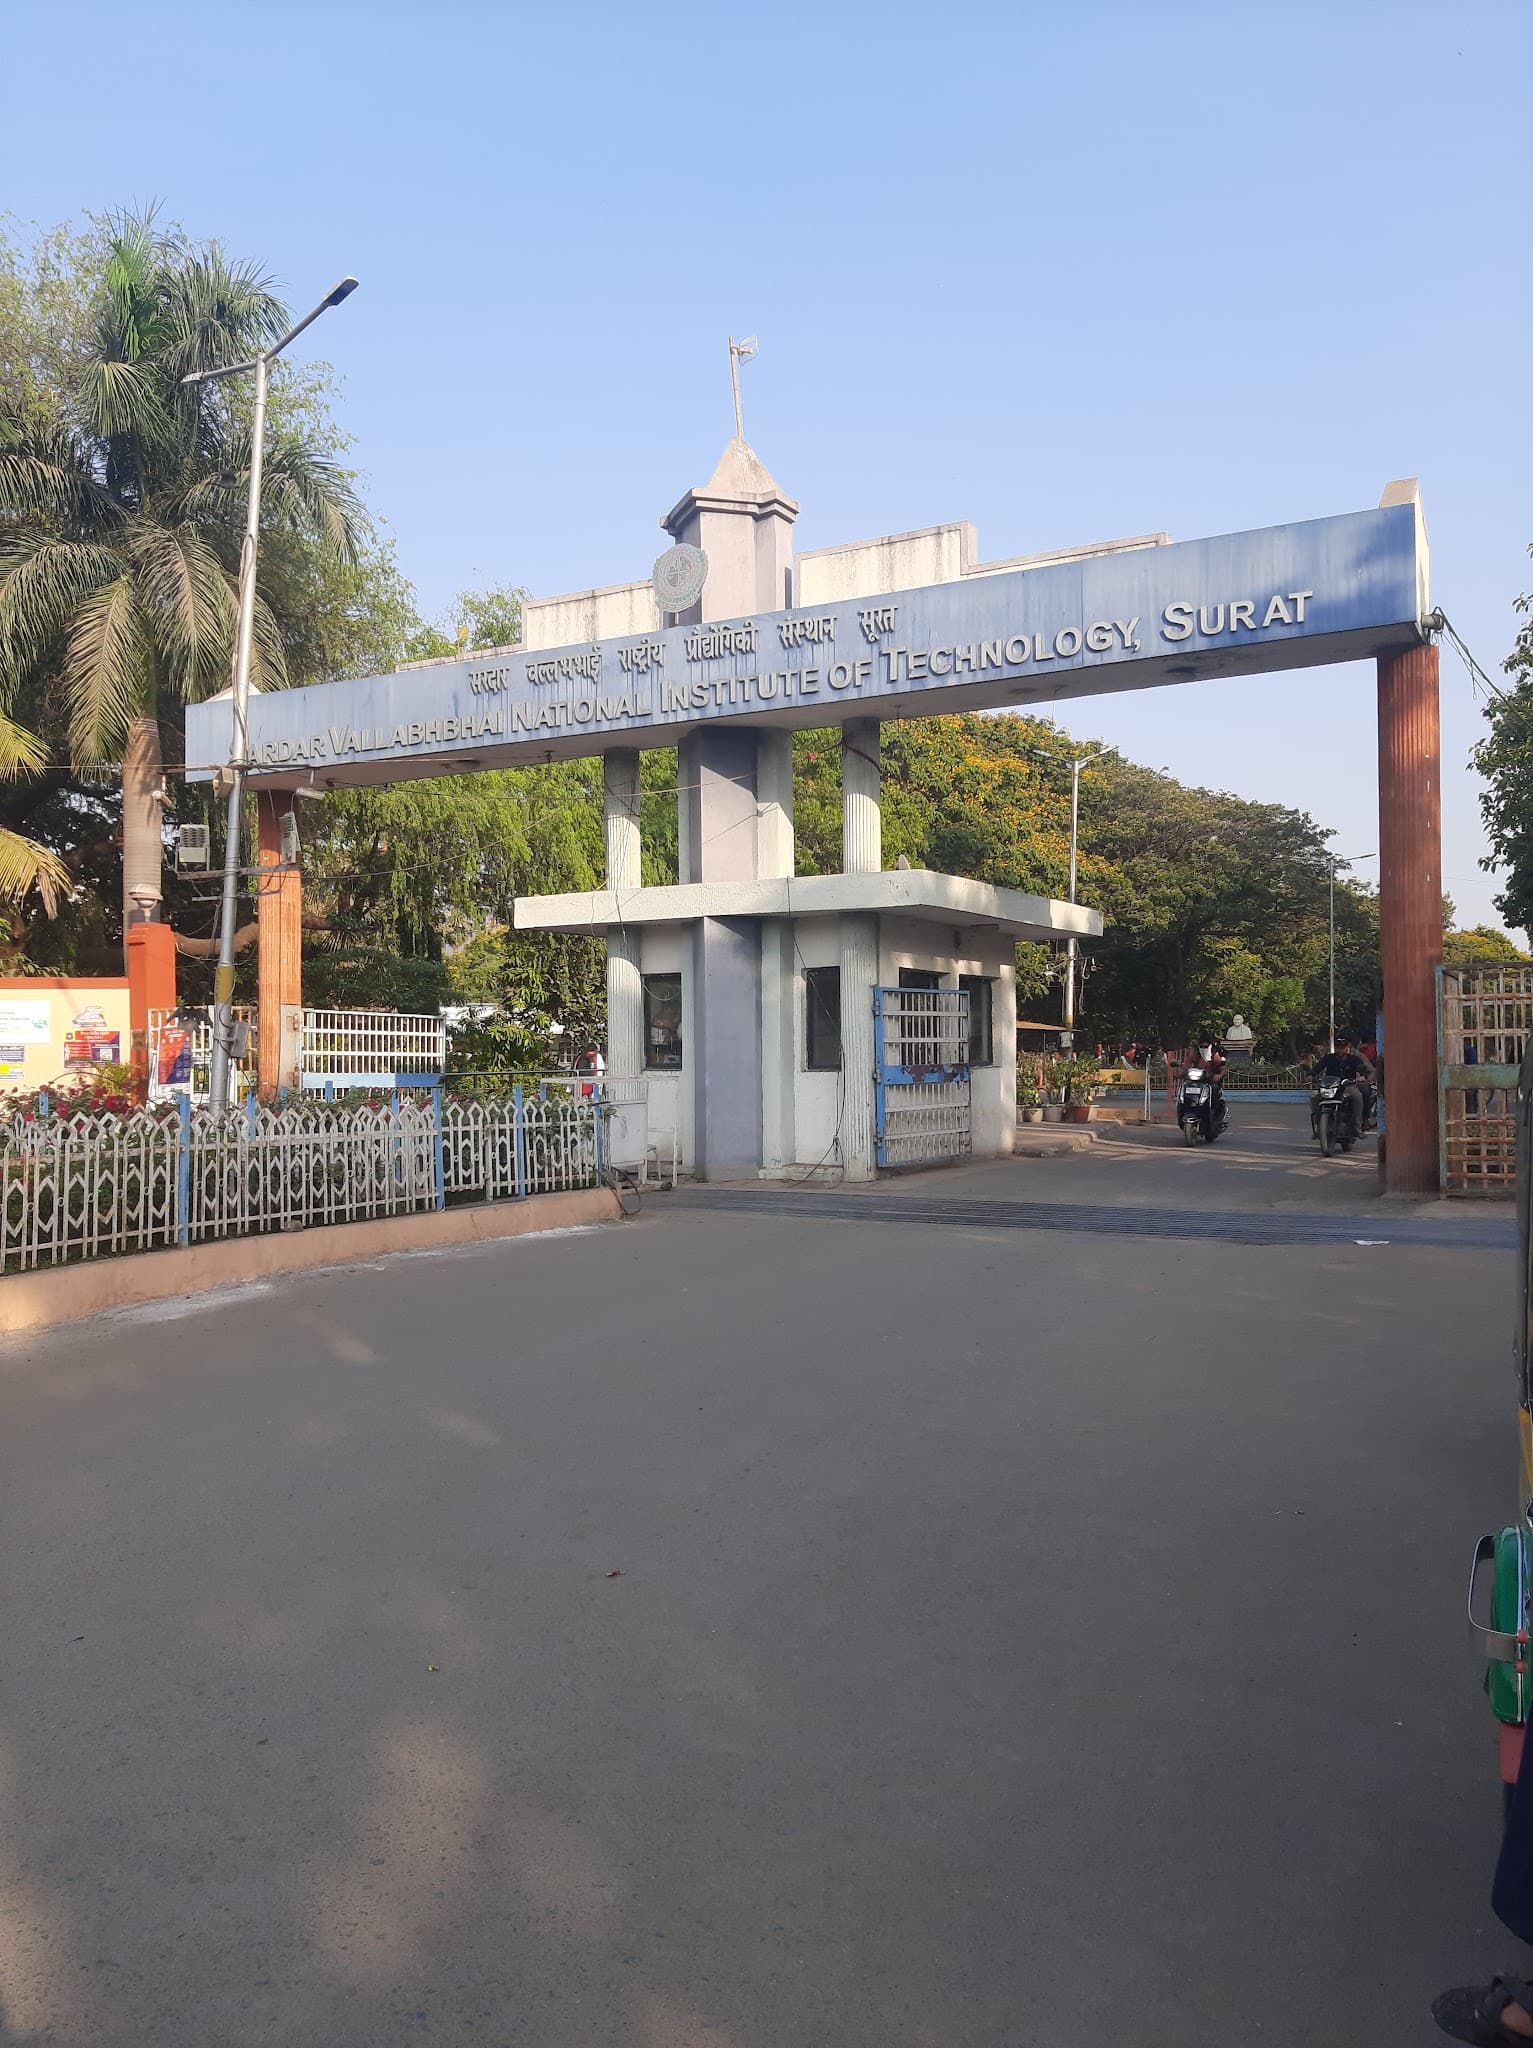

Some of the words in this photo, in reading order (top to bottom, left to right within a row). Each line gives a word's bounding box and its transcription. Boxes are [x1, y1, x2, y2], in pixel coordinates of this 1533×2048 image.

[231, 735, 326, 766] ARDAR
[329, 711, 504, 755] VALLABHBHAI
[511, 693, 652, 732] NATIONAL
[660, 667, 819, 713] INSTITUTE
[828, 657, 872, 690] OF
[882, 616, 1141, 682] TECHNOLOGY,
[1161, 590, 1313, 641] SURAT
[778, 614, 838, 649] संस्थान
[858, 606, 898, 644] सूरत
